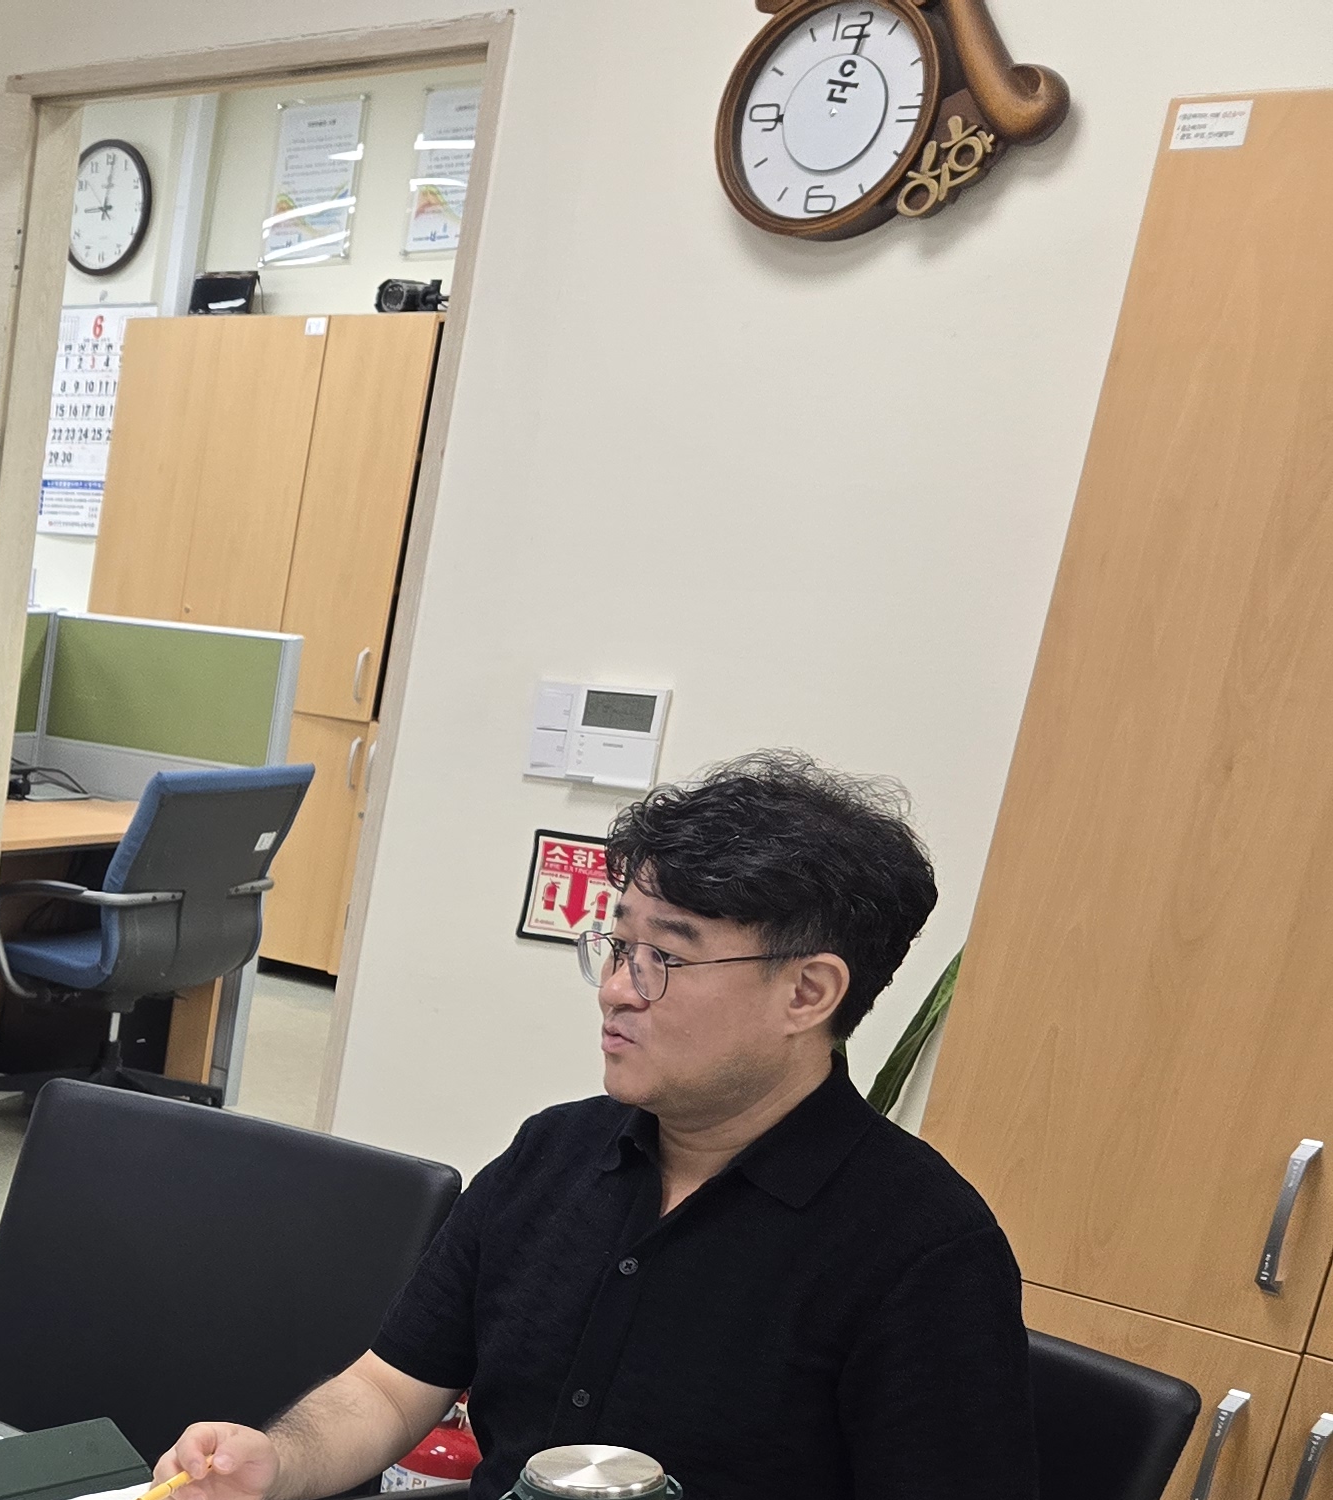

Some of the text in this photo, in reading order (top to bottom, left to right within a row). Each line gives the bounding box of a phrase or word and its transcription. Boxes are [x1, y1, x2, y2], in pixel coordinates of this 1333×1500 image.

[803, 185, 837, 213] 6
[93, 314, 104, 339] 6
[77, 356, 84, 369] 2
[103, 355, 110, 368] 4
[85, 381, 95, 394] 10
[55, 404, 65, 418] 15
[68, 405, 78, 418] 16
[81, 405, 91, 418] 17
[51, 428, 63, 441] 22
[64, 428, 76, 441] 23
[77, 428, 88, 441] 24
[91, 428, 102, 441] 25
[48, 452, 72, 465] 29 30
